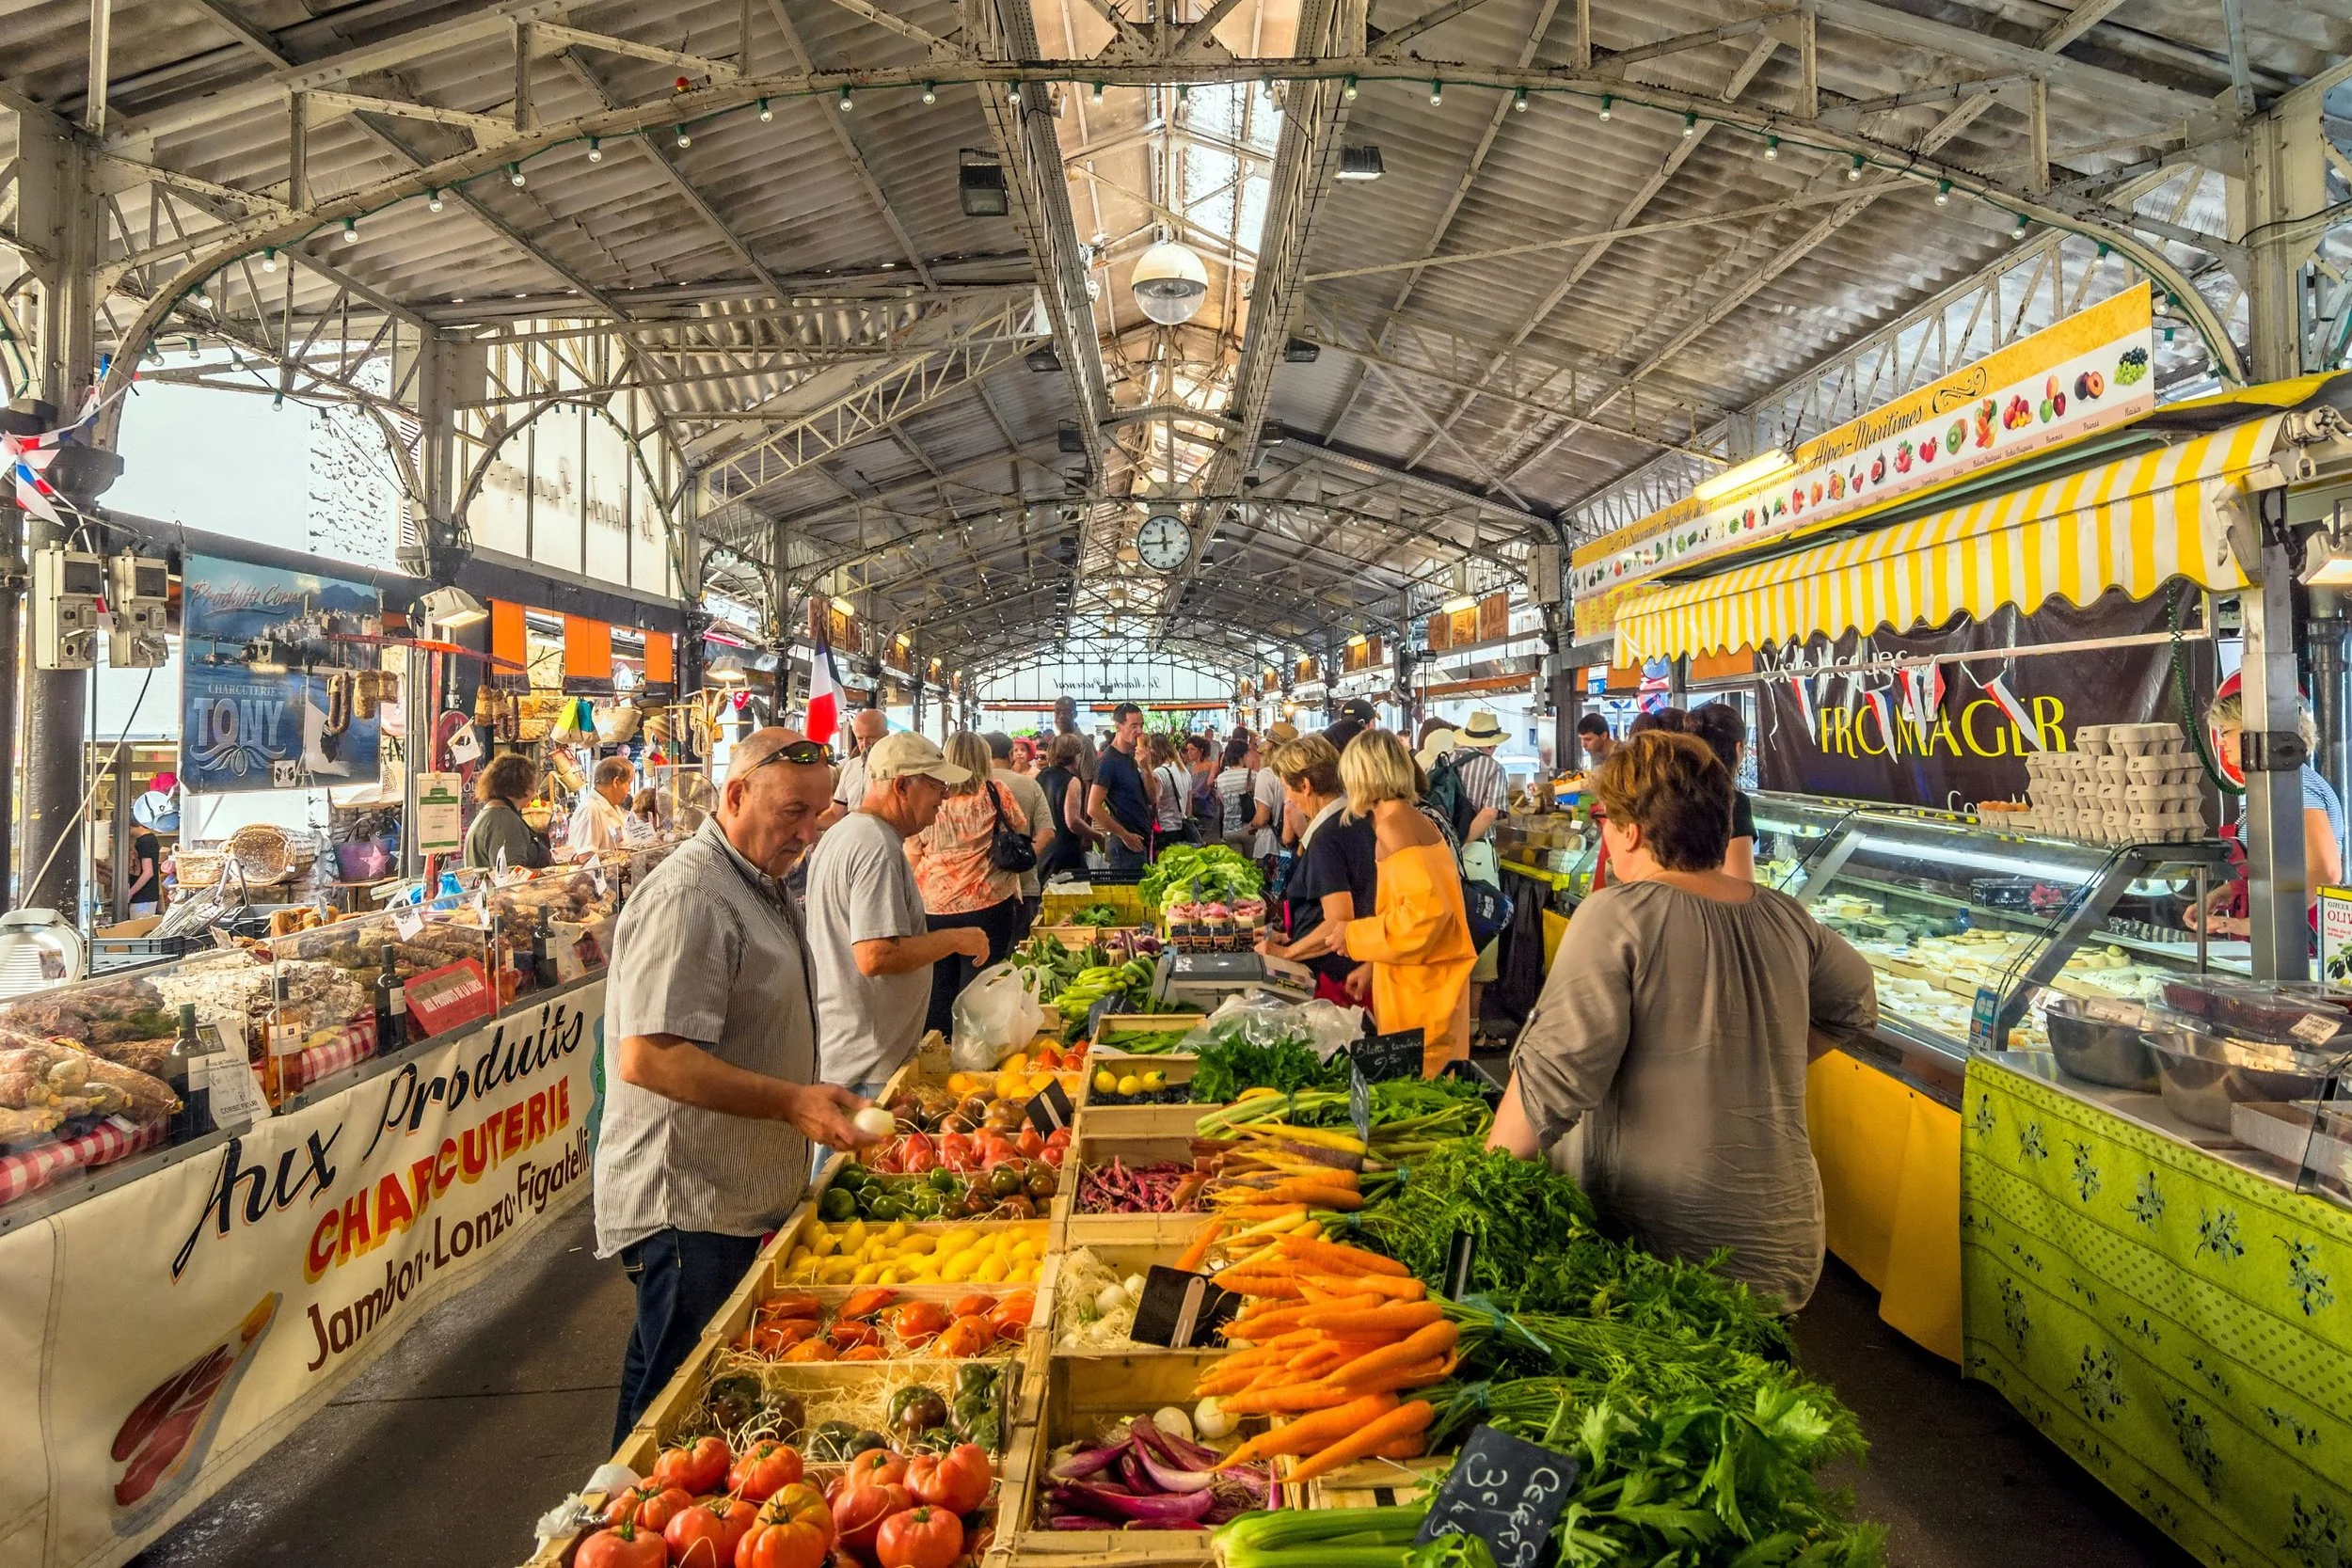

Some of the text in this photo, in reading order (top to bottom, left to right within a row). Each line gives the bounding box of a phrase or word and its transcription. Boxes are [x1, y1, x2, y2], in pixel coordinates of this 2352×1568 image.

[1811, 404, 1924, 471] Alpes-Maritimes
[2124, 404, 2142, 417] Raisin
[208, 684, 277, 698] CHARCUTERIE
[194, 697, 285, 747] TONY
[421, 998, 437, 1013] AUX
[171, 1001, 584, 1280] Aux Produits
[303, 1075, 570, 1285] CHARCUTERIE
[307, 1126, 592, 1372] Jambon Lonzo Figatelli
